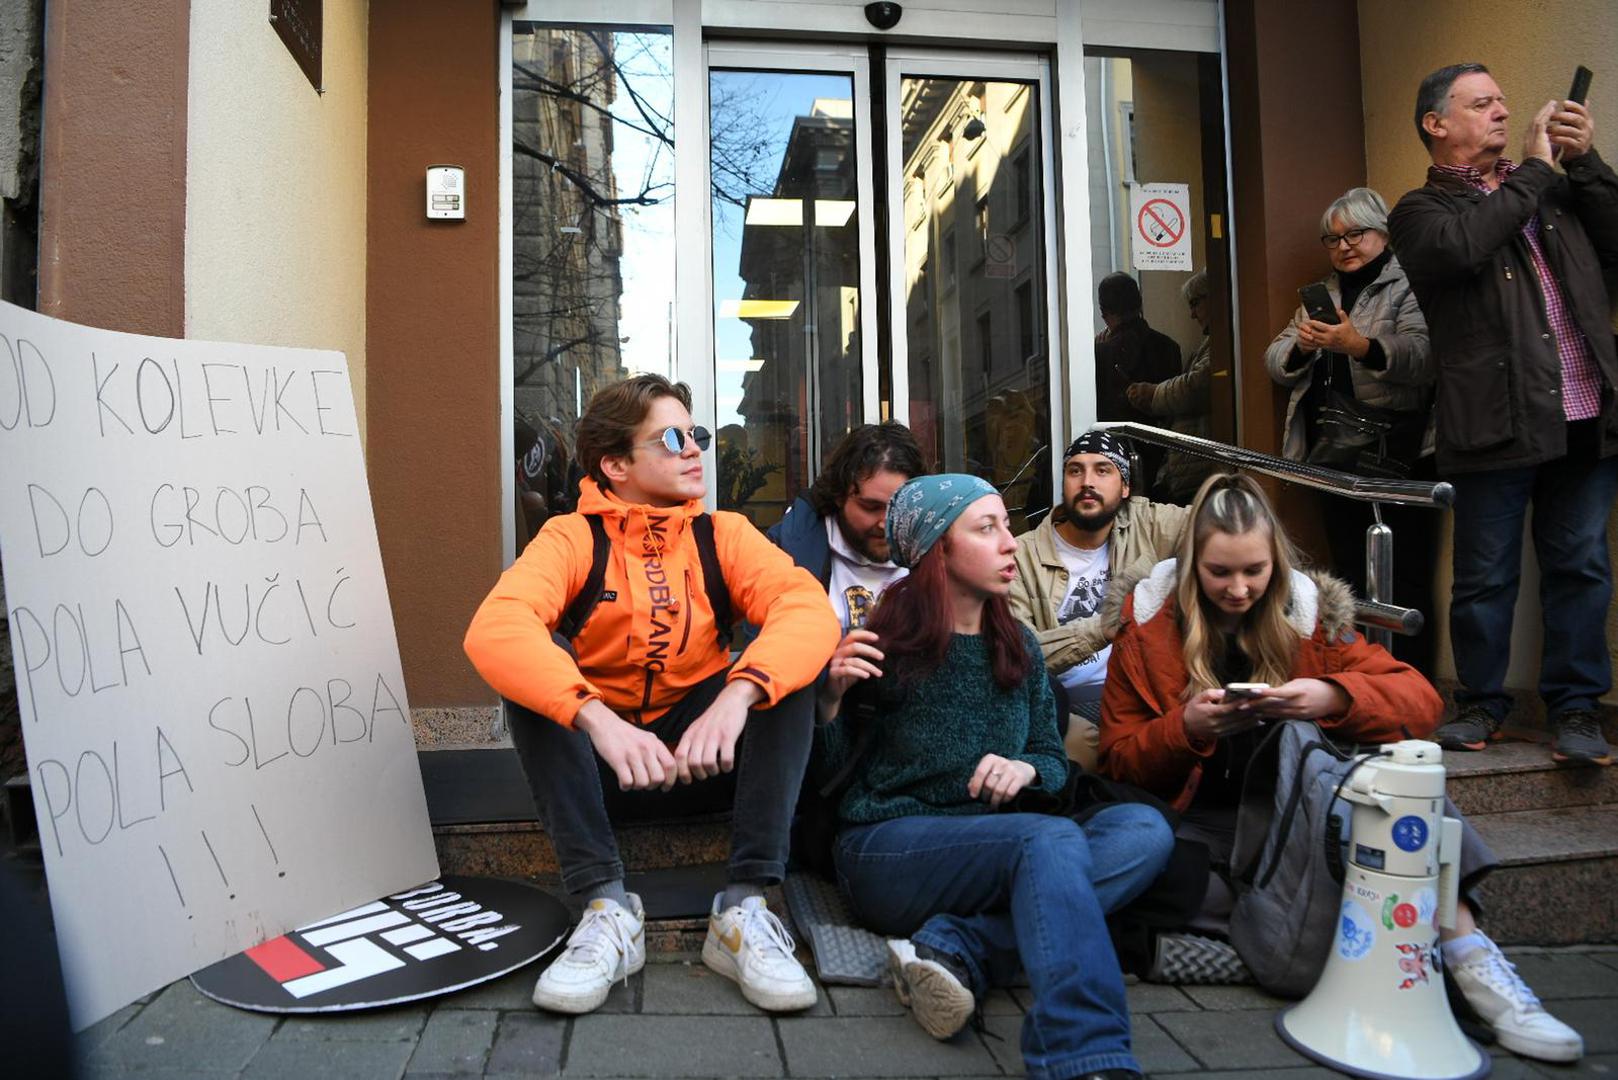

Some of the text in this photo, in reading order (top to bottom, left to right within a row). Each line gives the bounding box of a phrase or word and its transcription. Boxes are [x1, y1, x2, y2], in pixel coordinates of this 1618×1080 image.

[0, 332, 353, 440] OD KOLEVKE
[27, 483, 328, 559] DO GROBA
[11, 567, 356, 723] POLA VUČIĆ
[36, 672, 408, 858] POLA SLOBA
